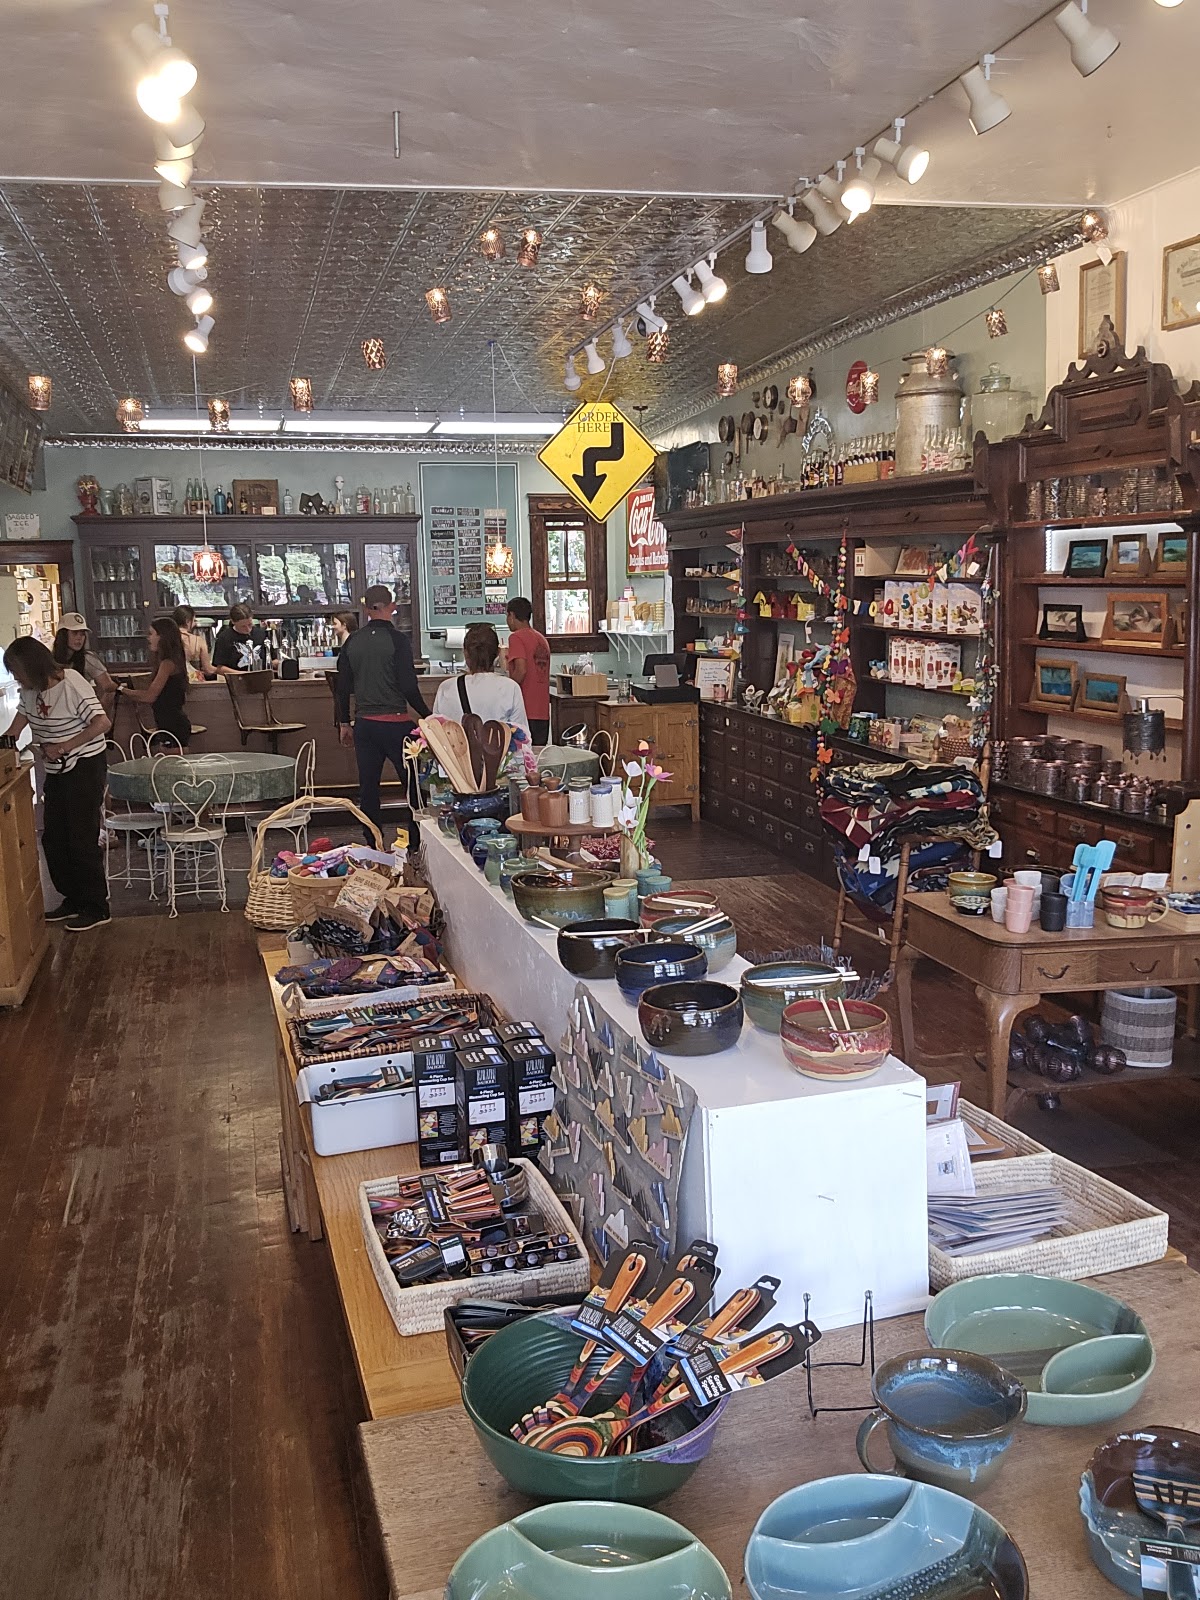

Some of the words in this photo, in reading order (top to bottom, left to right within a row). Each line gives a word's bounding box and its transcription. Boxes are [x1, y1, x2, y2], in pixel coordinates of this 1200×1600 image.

[578, 411, 620, 422] ORDER
[577, 422, 611, 433] HERE
[633, 1340, 649, 1354] Server
[635, 1332, 657, 1352] Spaghetti
[701, 1380, 712, 1399] Spoon
[706, 1375, 719, 1397] Serving
[713, 1374, 726, 1392] Grand
